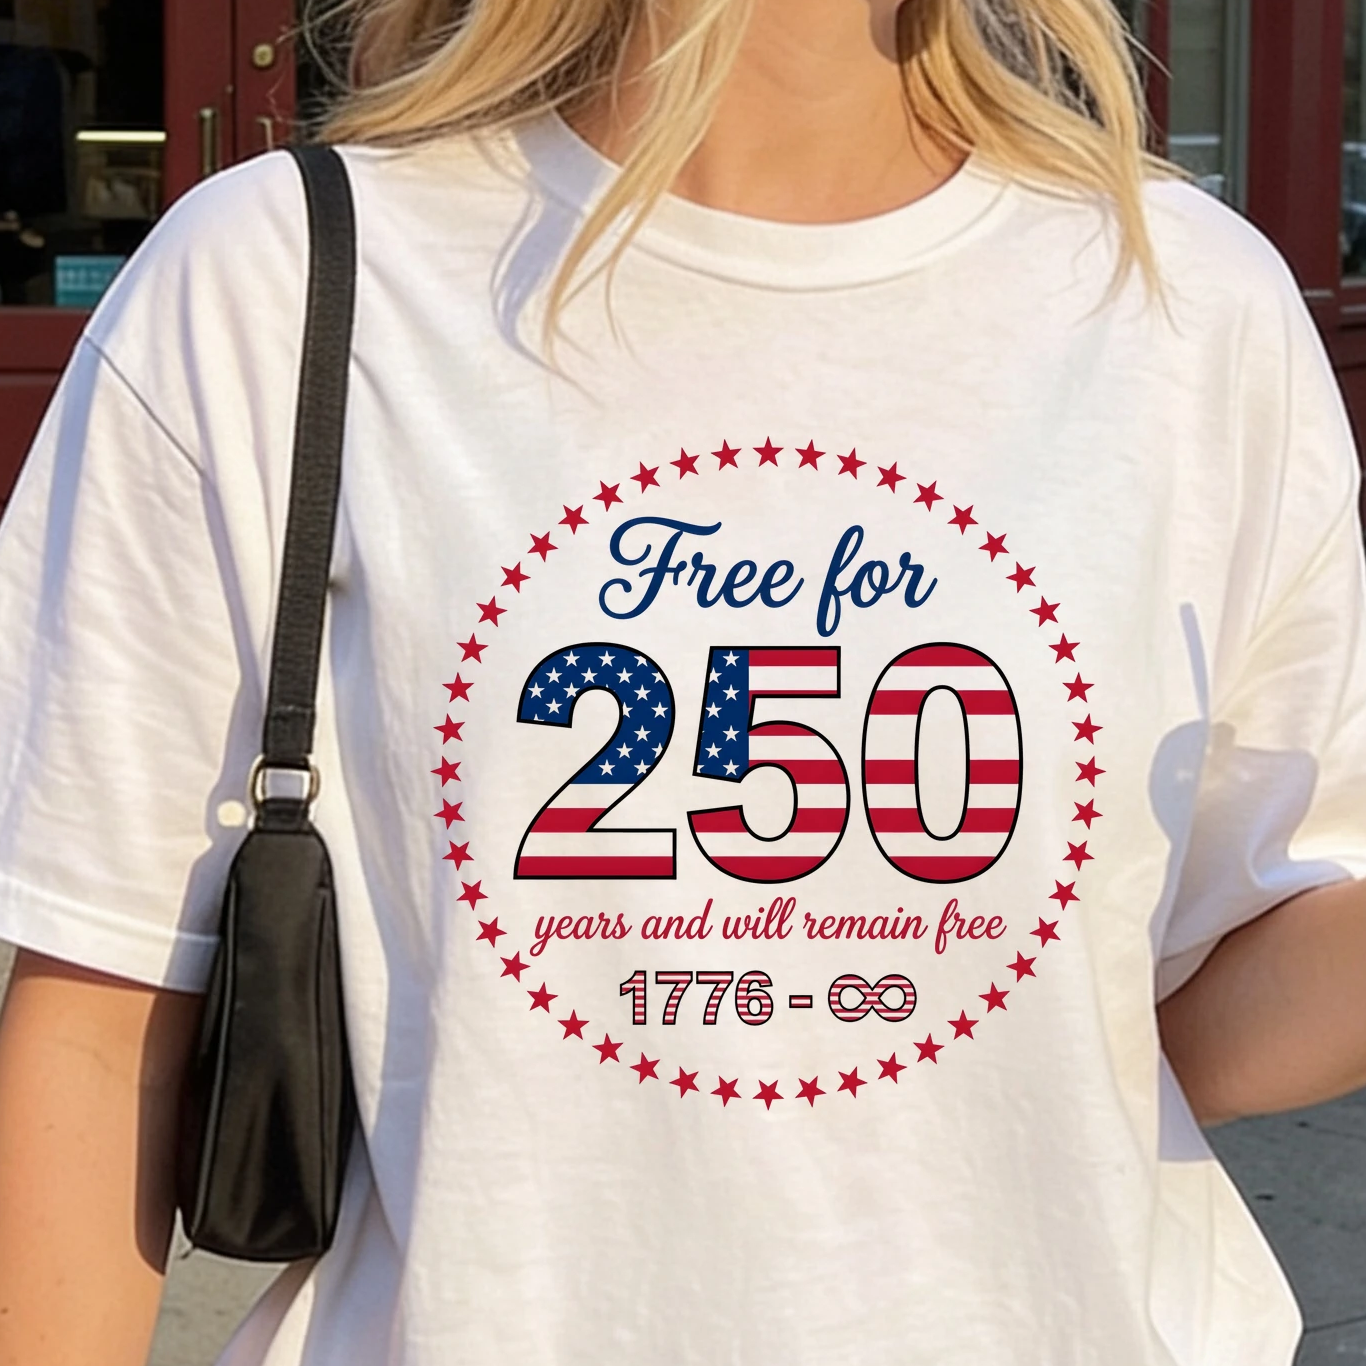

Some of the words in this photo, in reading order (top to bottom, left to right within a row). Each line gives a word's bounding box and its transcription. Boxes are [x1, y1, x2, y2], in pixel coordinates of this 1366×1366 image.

[598, 516, 805, 620] Free
[816, 524, 938, 638] for
[513, 641, 1024, 885] 250
[529, 911, 632, 958] years
[640, 897, 714, 940] and
[721, 896, 797, 940] will
[802, 906, 928, 940] remain
[934, 898, 1008, 956] free
[619, 970, 774, 1026] 1776
